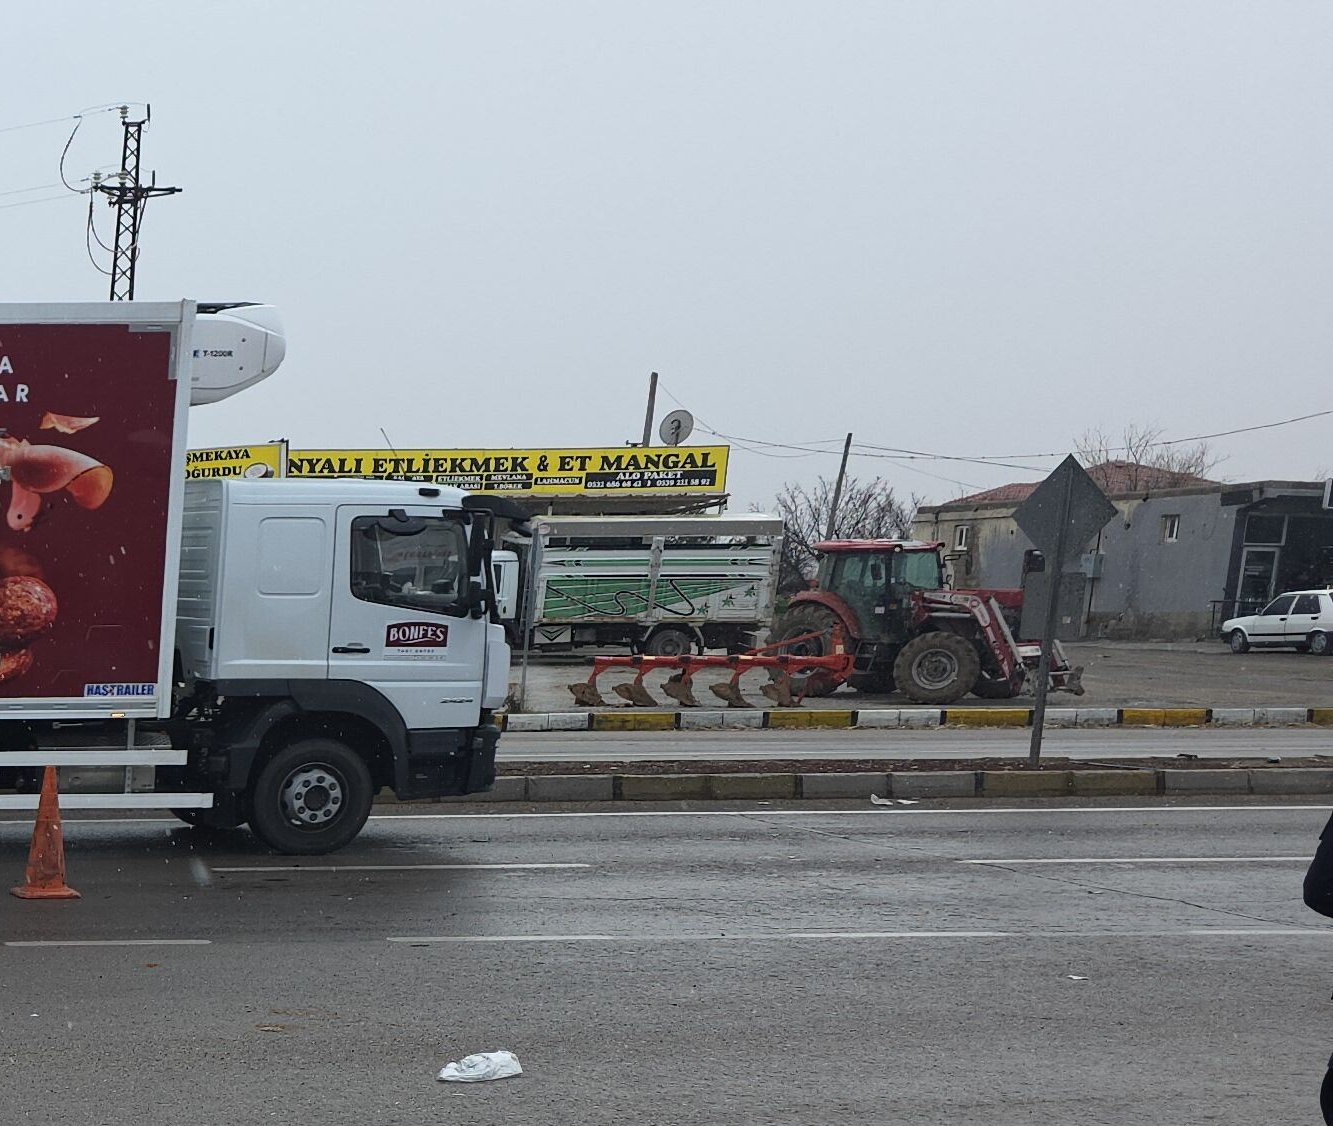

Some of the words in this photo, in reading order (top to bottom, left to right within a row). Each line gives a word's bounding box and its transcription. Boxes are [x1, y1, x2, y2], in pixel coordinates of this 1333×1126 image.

[372, 453, 530, 473] ETLİEKMEK
[536, 454, 549, 472] &
[558, 455, 593, 472] ET
[598, 452, 716, 471] MANGAL
[536, 477, 580, 485] LAHMACUN
[615, 472, 641, 480] ALO
[643, 470, 683, 480] PAKET
[389, 625, 446, 642] BONFES
